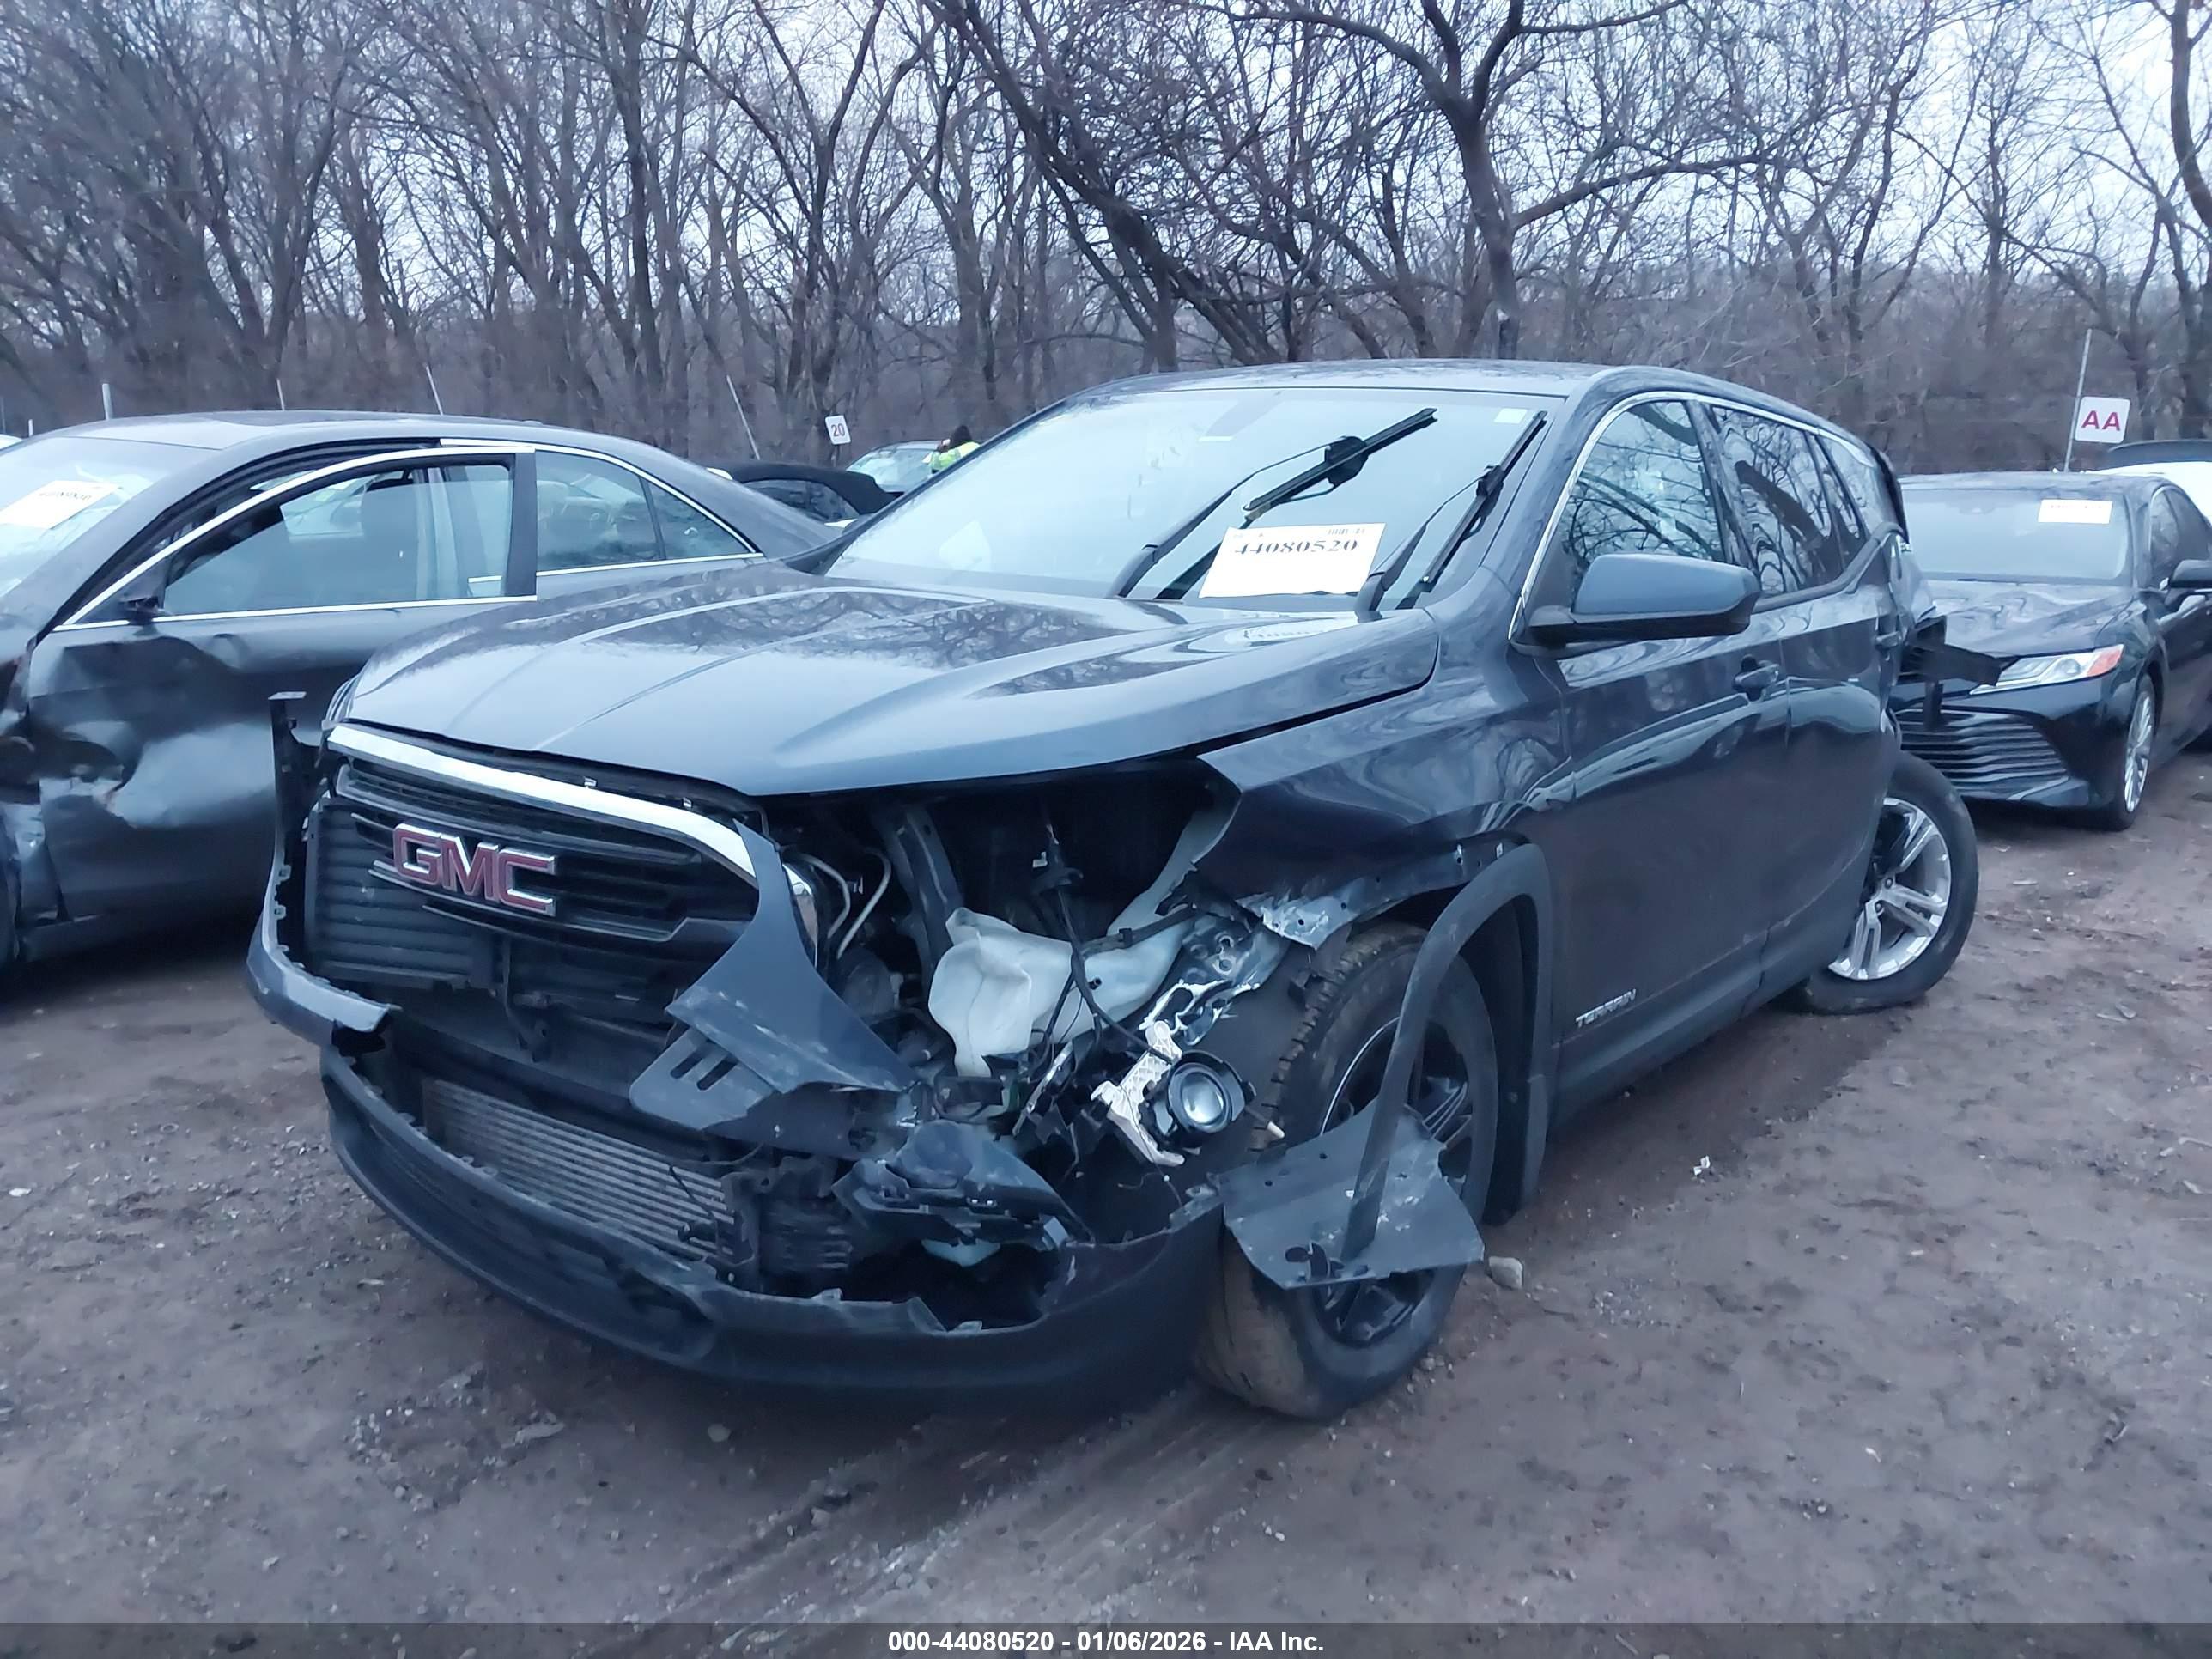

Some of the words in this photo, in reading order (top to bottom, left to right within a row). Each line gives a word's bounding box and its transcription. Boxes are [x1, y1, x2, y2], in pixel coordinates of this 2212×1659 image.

[830, 422, 846, 437] 20
[2081, 410, 2121, 432] AA
[1234, 539, 1358, 555] 44080520
[392, 823, 556, 917] GMC
